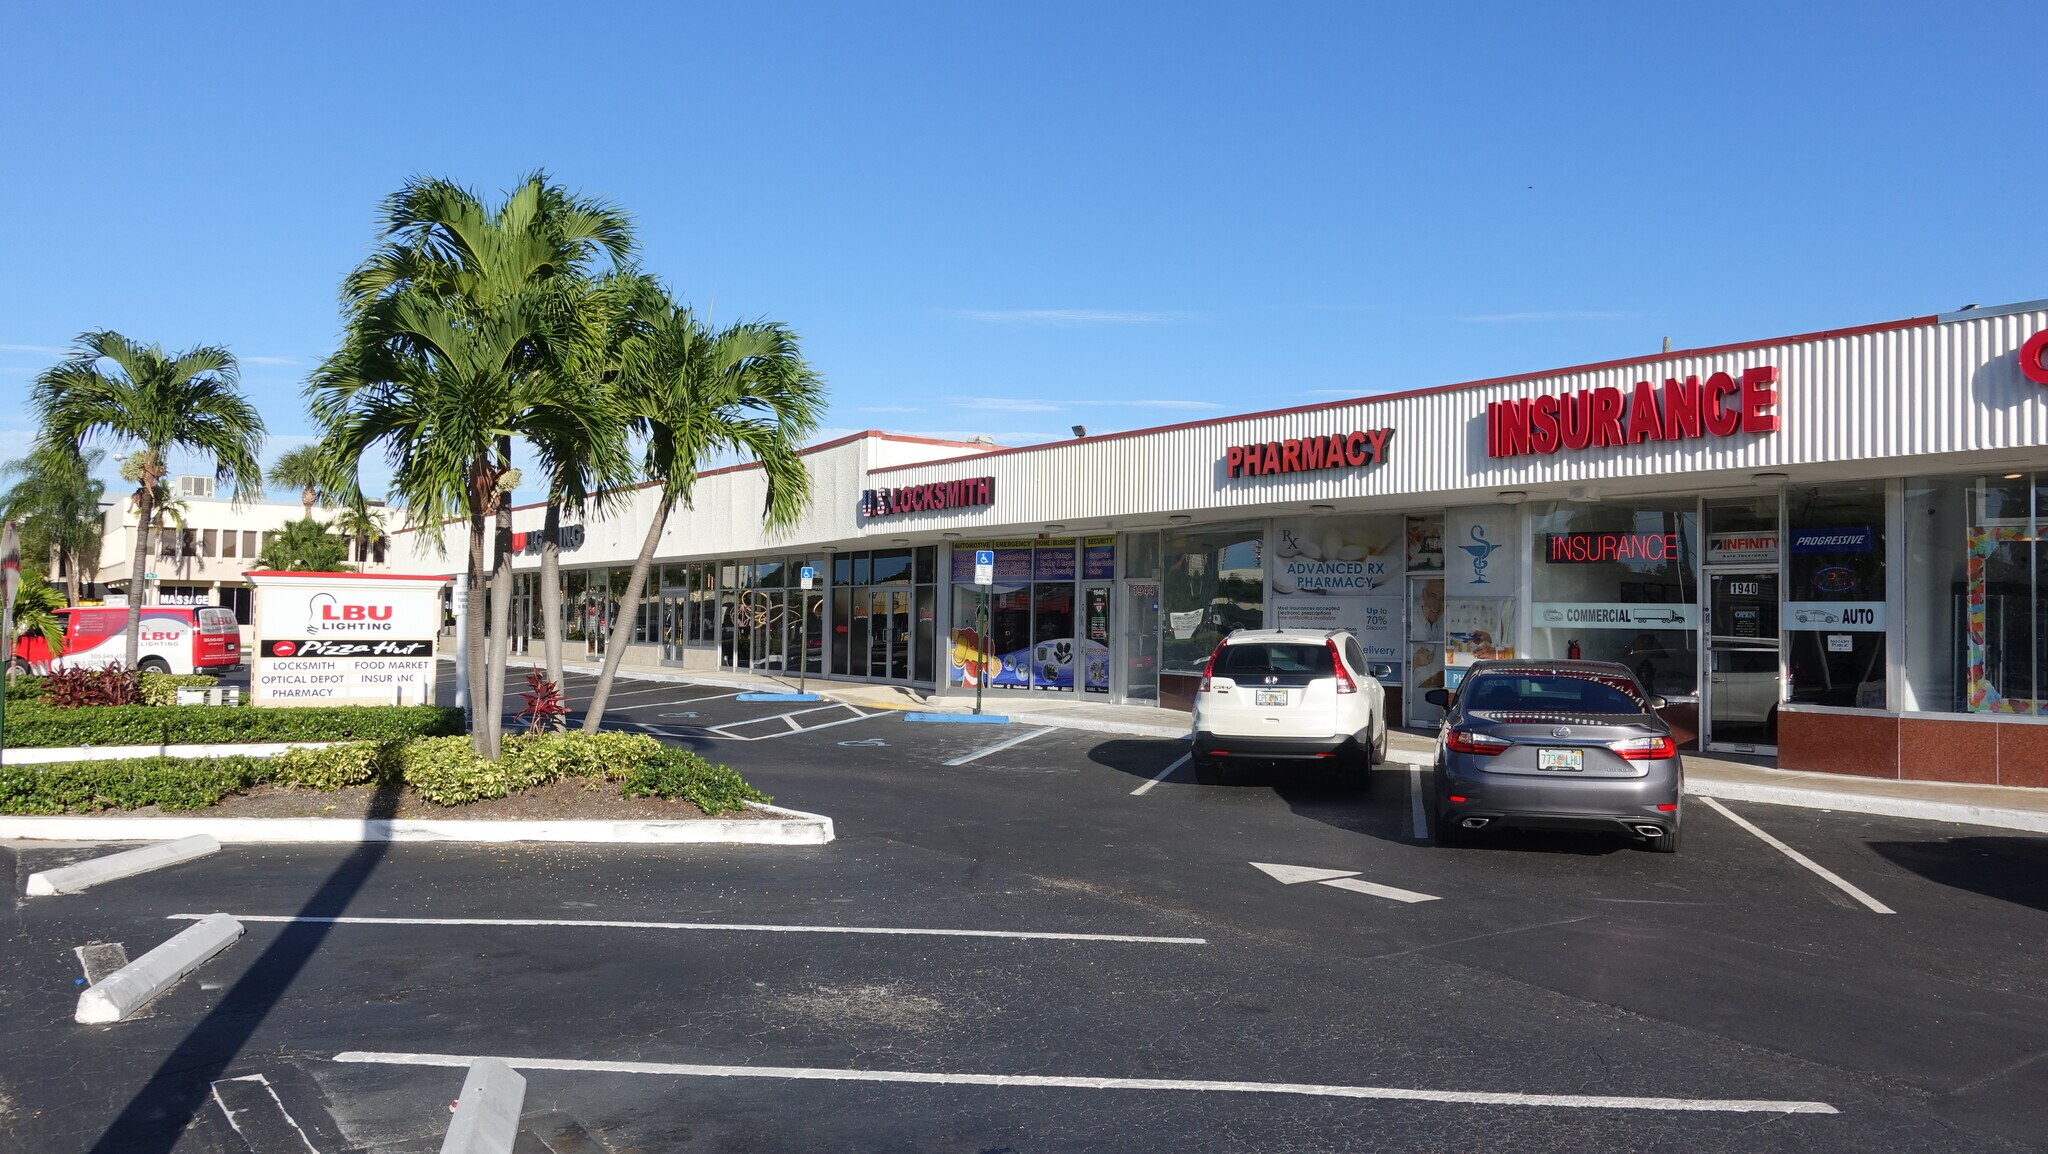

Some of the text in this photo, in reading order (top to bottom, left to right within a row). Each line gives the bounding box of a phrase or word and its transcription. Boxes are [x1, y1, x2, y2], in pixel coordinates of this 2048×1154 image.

[1487, 365, 1779, 459] INSURANCE
[1227, 427, 1395, 478] PHARMACY
[892, 475, 995, 513] LOCKSMITH
[995, 540, 1032, 548] EMERGENCY
[1087, 537, 1114, 546] SECURITY
[1723, 537, 1779, 550] INFINITY
[1796, 534, 1866, 546] PROGRESSIVE
[1552, 534, 1678, 561] INSURANCE
[1287, 563, 1385, 575] ADVANCED RX
[1297, 576, 1373, 589] PHARMACY
[1133, 585, 1155, 597] 1944
[1731, 583, 1757, 594] 1940
[160, 594, 209, 605] MASSAGE
[322, 604, 393, 621] LBU
[1366, 607, 1379, 616] Up
[1566, 608, 1631, 623] COMMERCIAL
[1734, 610, 1756, 619] OPEN
[1842, 608, 1874, 625] AUTO
[210, 616, 233, 626] LBU
[1366, 615, 1388, 625] 70%
[321, 622, 392, 631] LIGHTING
[141, 631, 180, 641] LBU
[297, 640, 426, 657] Pizza Hut
[1363, 645, 1396, 656] elivery
[273, 661, 336, 671] LOCKSMITH
[354, 660, 429, 670] FOOD MARKET
[261, 675, 345, 684] OPTICAL DEPOT
[361, 674, 414, 683] INSURNC
[272, 688, 333, 698] PHARMACY
[1541, 753, 1581, 766] 773 LHU
